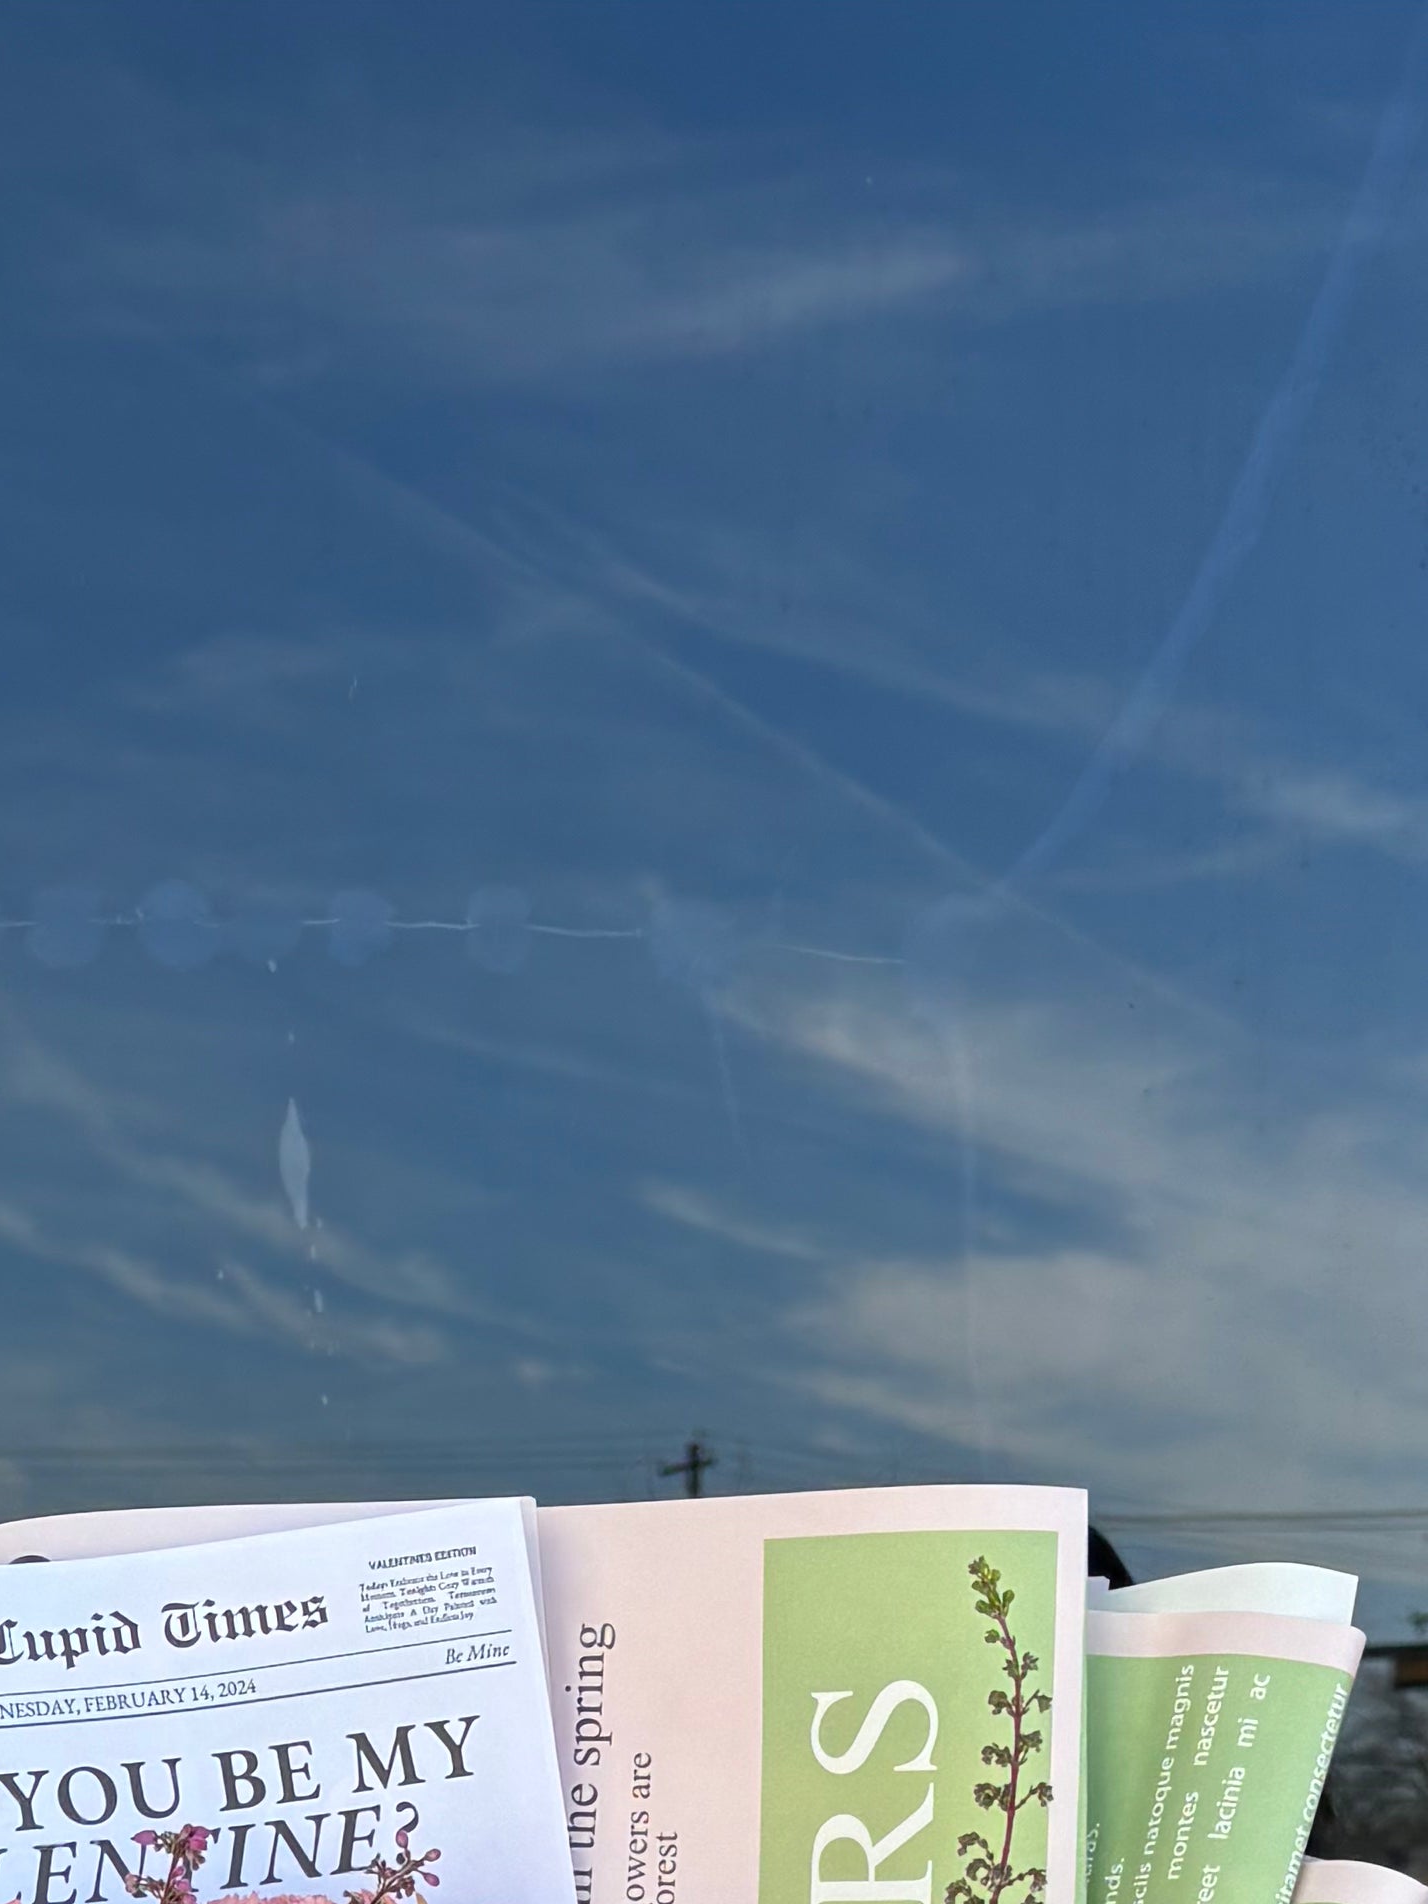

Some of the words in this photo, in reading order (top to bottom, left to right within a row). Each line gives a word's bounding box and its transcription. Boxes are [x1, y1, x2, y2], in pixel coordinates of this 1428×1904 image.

[160, 1584, 330, 1650] Times
[444, 1647, 464, 1664] Be
[466, 1641, 510, 1661] Mine
[84, 1685, 187, 1717] FEBRUARY
[189, 1682, 218, 1706] 14,
[219, 1676, 258, 1701] 2024
[562, 1620, 616, 1767] spring
[212, 1740, 323, 1811] BE
[347, 1716, 481, 1791] MY
[630, 1751, 652, 1799] are
[1139, 1755, 1178, 1856] natoque
[1162, 1662, 1195, 1751] magnis
[1163, 1789, 1200, 1881] montes
[1189, 1664, 1230, 1767] nascetur
[1206, 1764, 1246, 1839] lacinia
[1235, 1716, 1259, 1748] mi
[1248, 1671, 1271, 1700] ac
[566, 1781, 599, 1849] the
